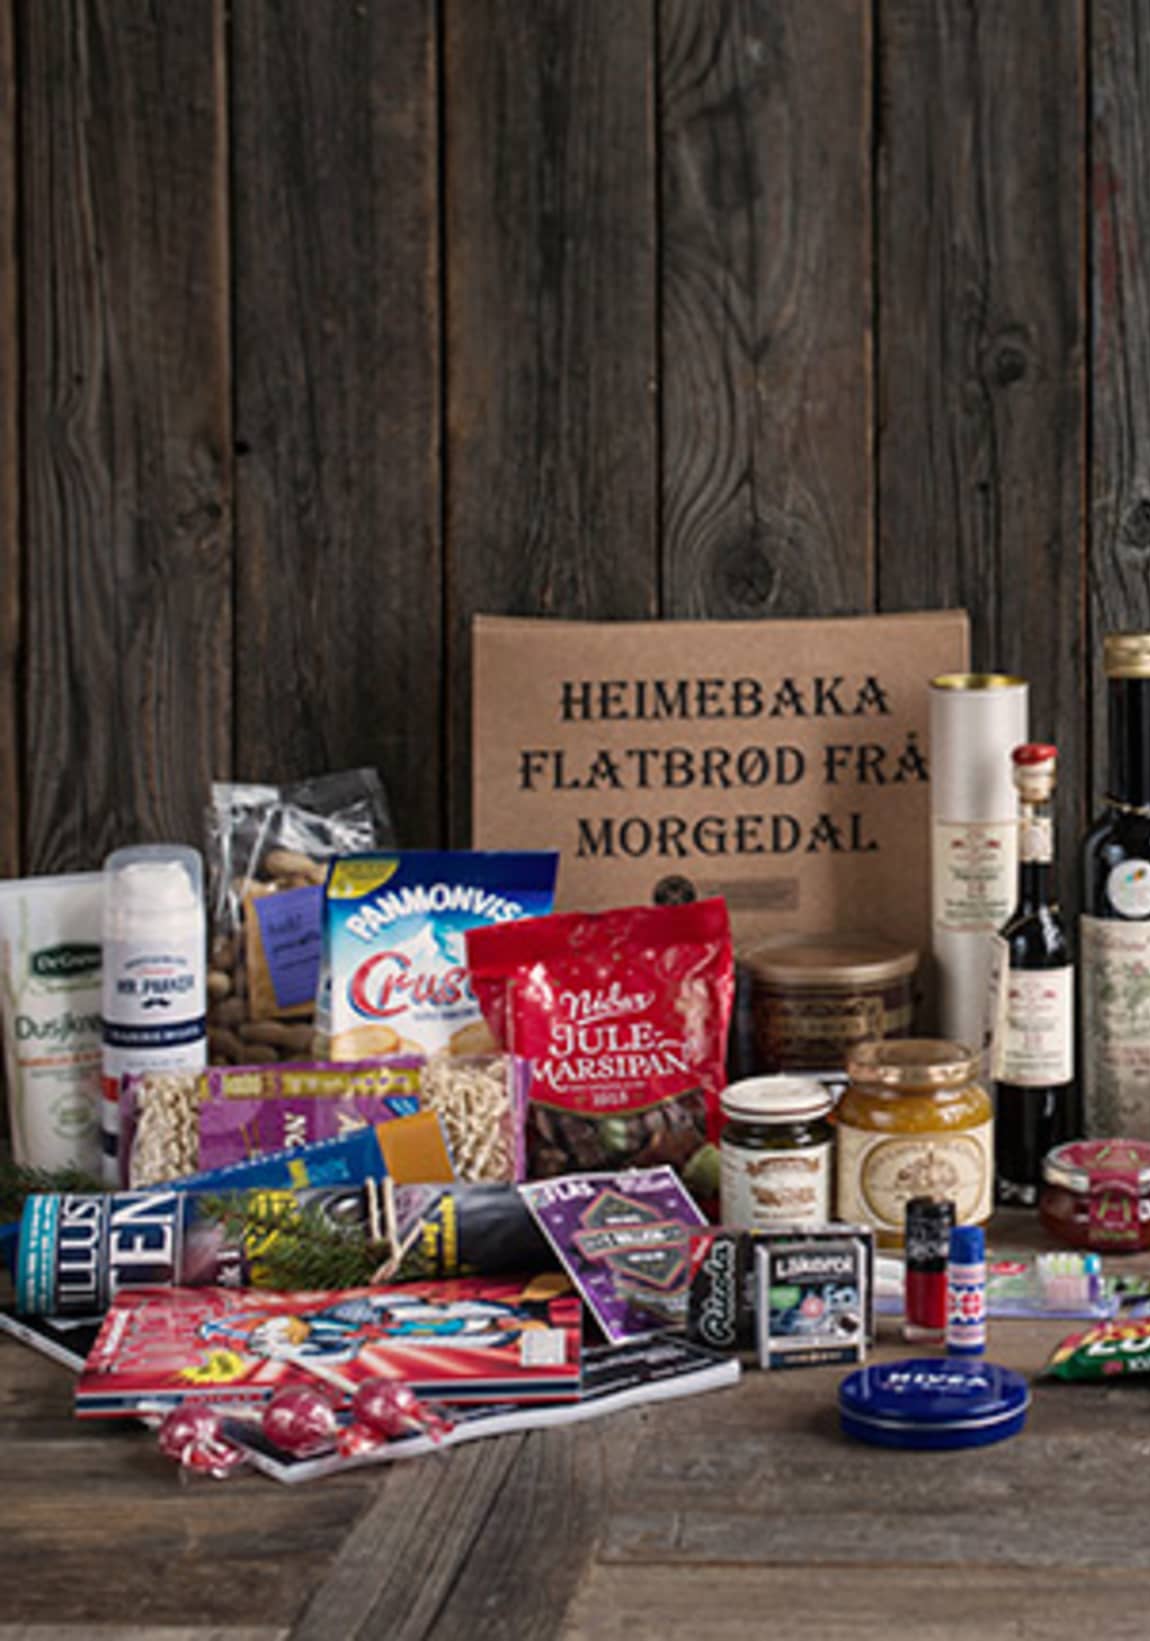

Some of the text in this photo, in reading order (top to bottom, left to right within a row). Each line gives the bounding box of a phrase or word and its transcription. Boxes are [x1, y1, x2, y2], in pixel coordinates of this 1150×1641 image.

[560, 676, 894, 721] HEIMEBAKA
[517, 732, 929, 790] FLATBRØD FRÅ
[576, 813, 879, 858] MORGEDAL
[346, 882, 530, 944] PANMONVIS
[532, 1048, 689, 1090] MARSIPAN
[888, 1371, 989, 1388] NIVEA
